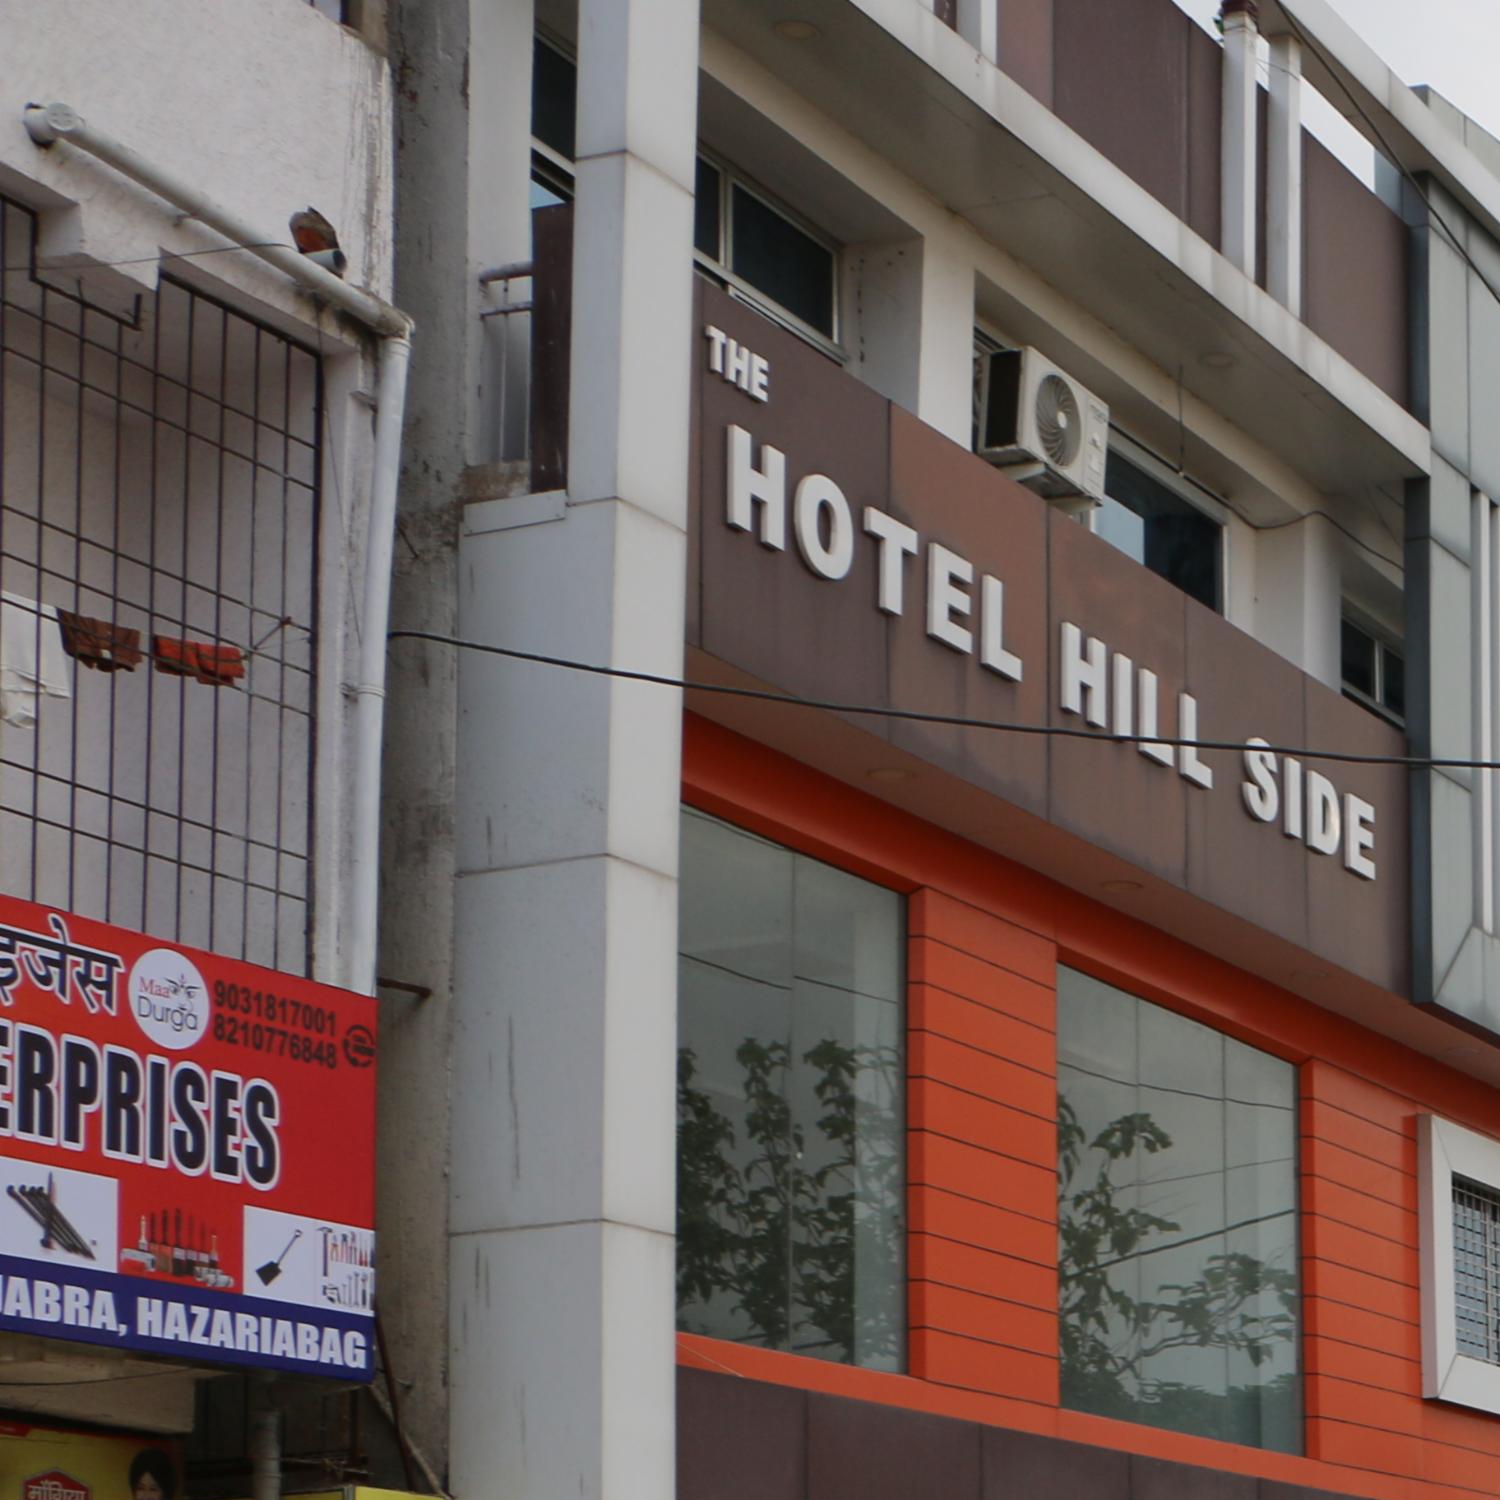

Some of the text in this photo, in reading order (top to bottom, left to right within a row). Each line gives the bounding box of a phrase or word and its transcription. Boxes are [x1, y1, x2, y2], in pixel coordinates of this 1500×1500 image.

[704, 324, 769, 403] THE
[725, 423, 1377, 882] HOTEL HILL SIDE
[137, 995, 199, 1033] Durga
[138, 976, 171, 999] Maa
[213, 979, 337, 1037] 9031817001
[213, 1013, 338, 1070] 8210776848
[0, 1274, 367, 1370] ABRA, HAZARIABAG
